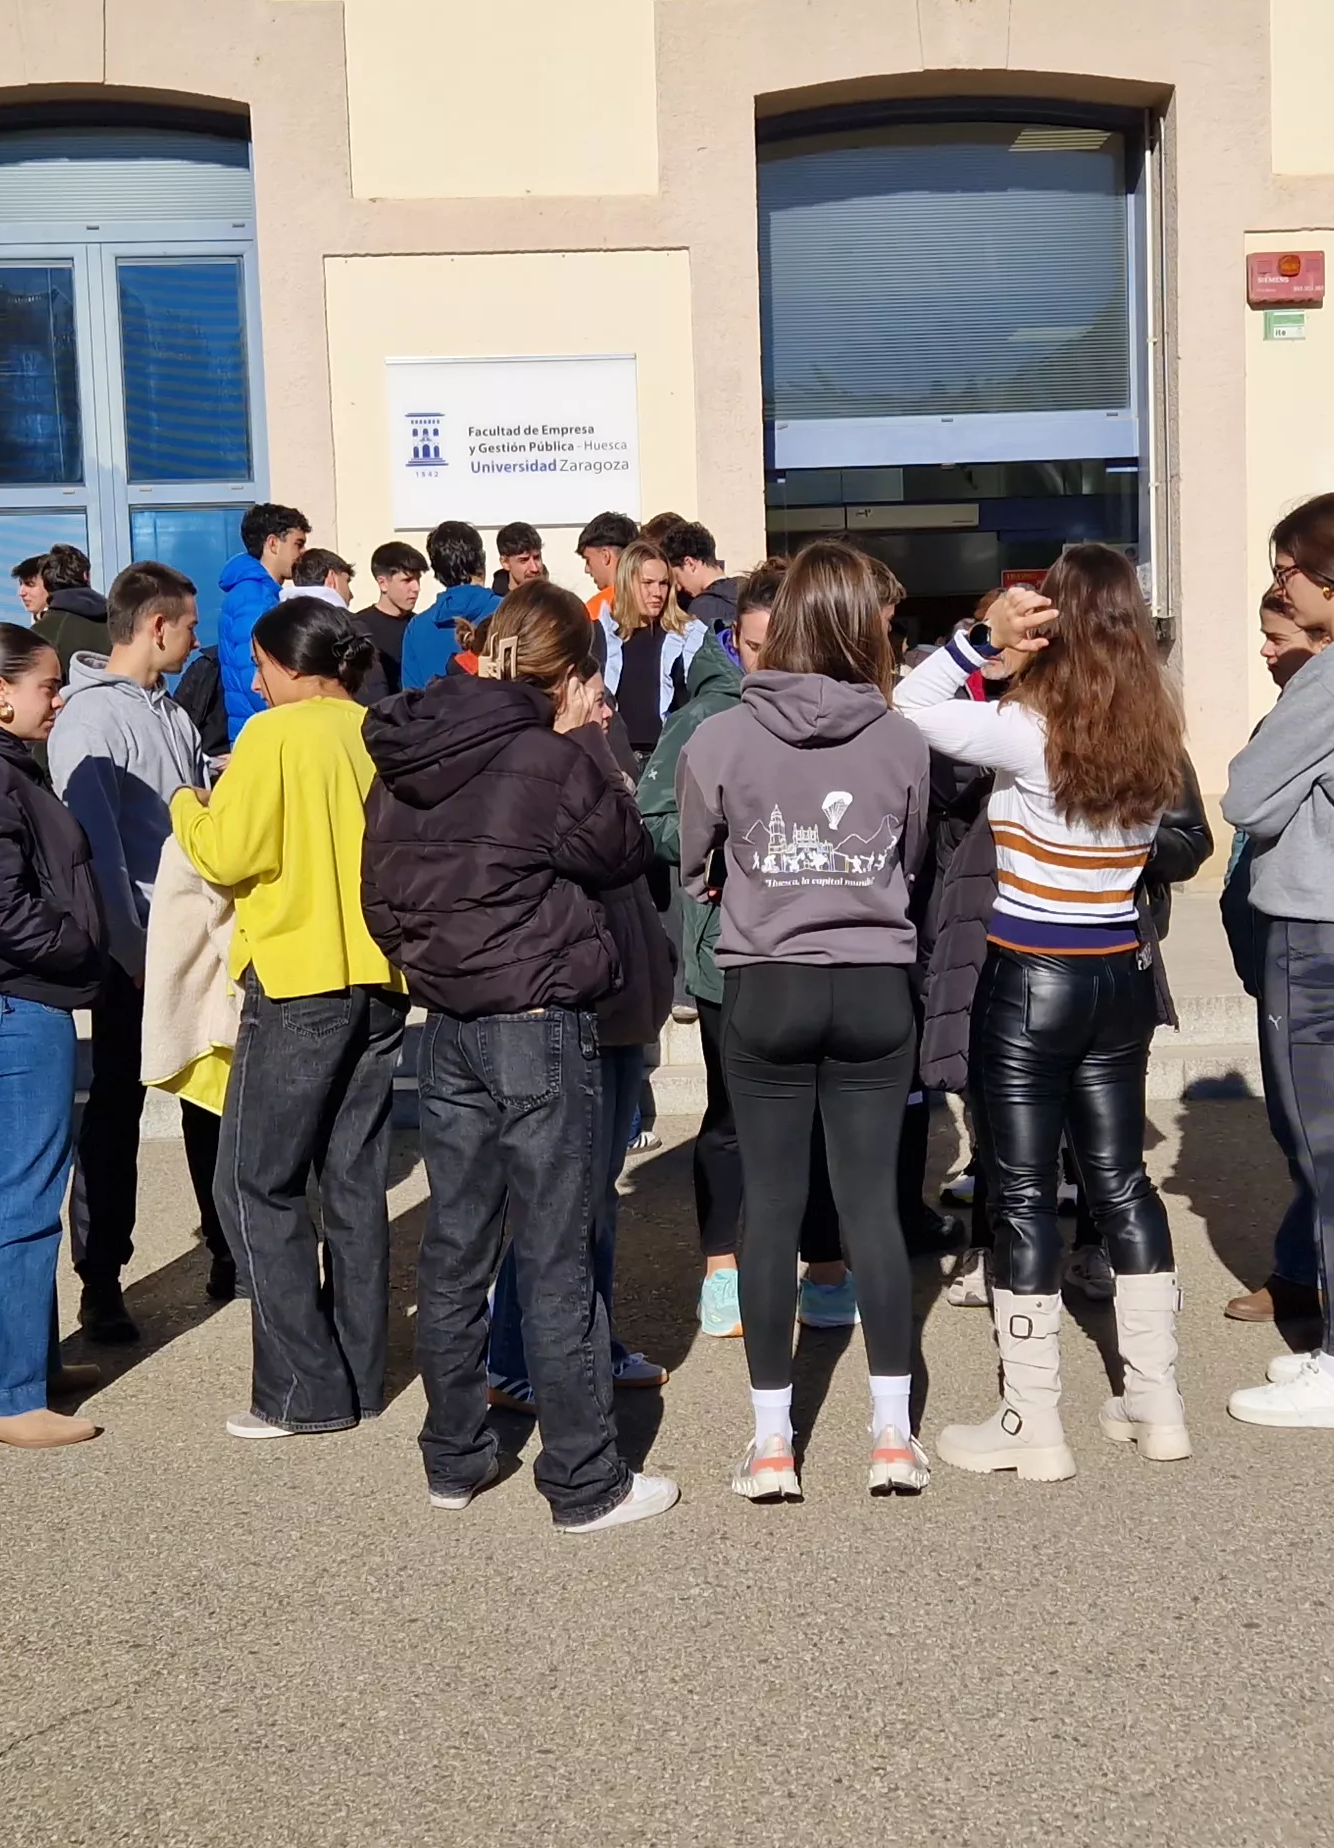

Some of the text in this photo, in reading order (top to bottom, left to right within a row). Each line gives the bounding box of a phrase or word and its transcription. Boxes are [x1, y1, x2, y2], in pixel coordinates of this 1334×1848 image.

[1257, 276, 1289, 284] SIEMENS
[468, 425, 595, 437] Facultad de Empresa
[469, 445, 476, 456] y
[478, 442, 526, 453] Gestión
[529, 441, 574, 452] Pública
[584, 440, 627, 451] Huesca
[470, 459, 629, 475] Universidad Zaragoza
